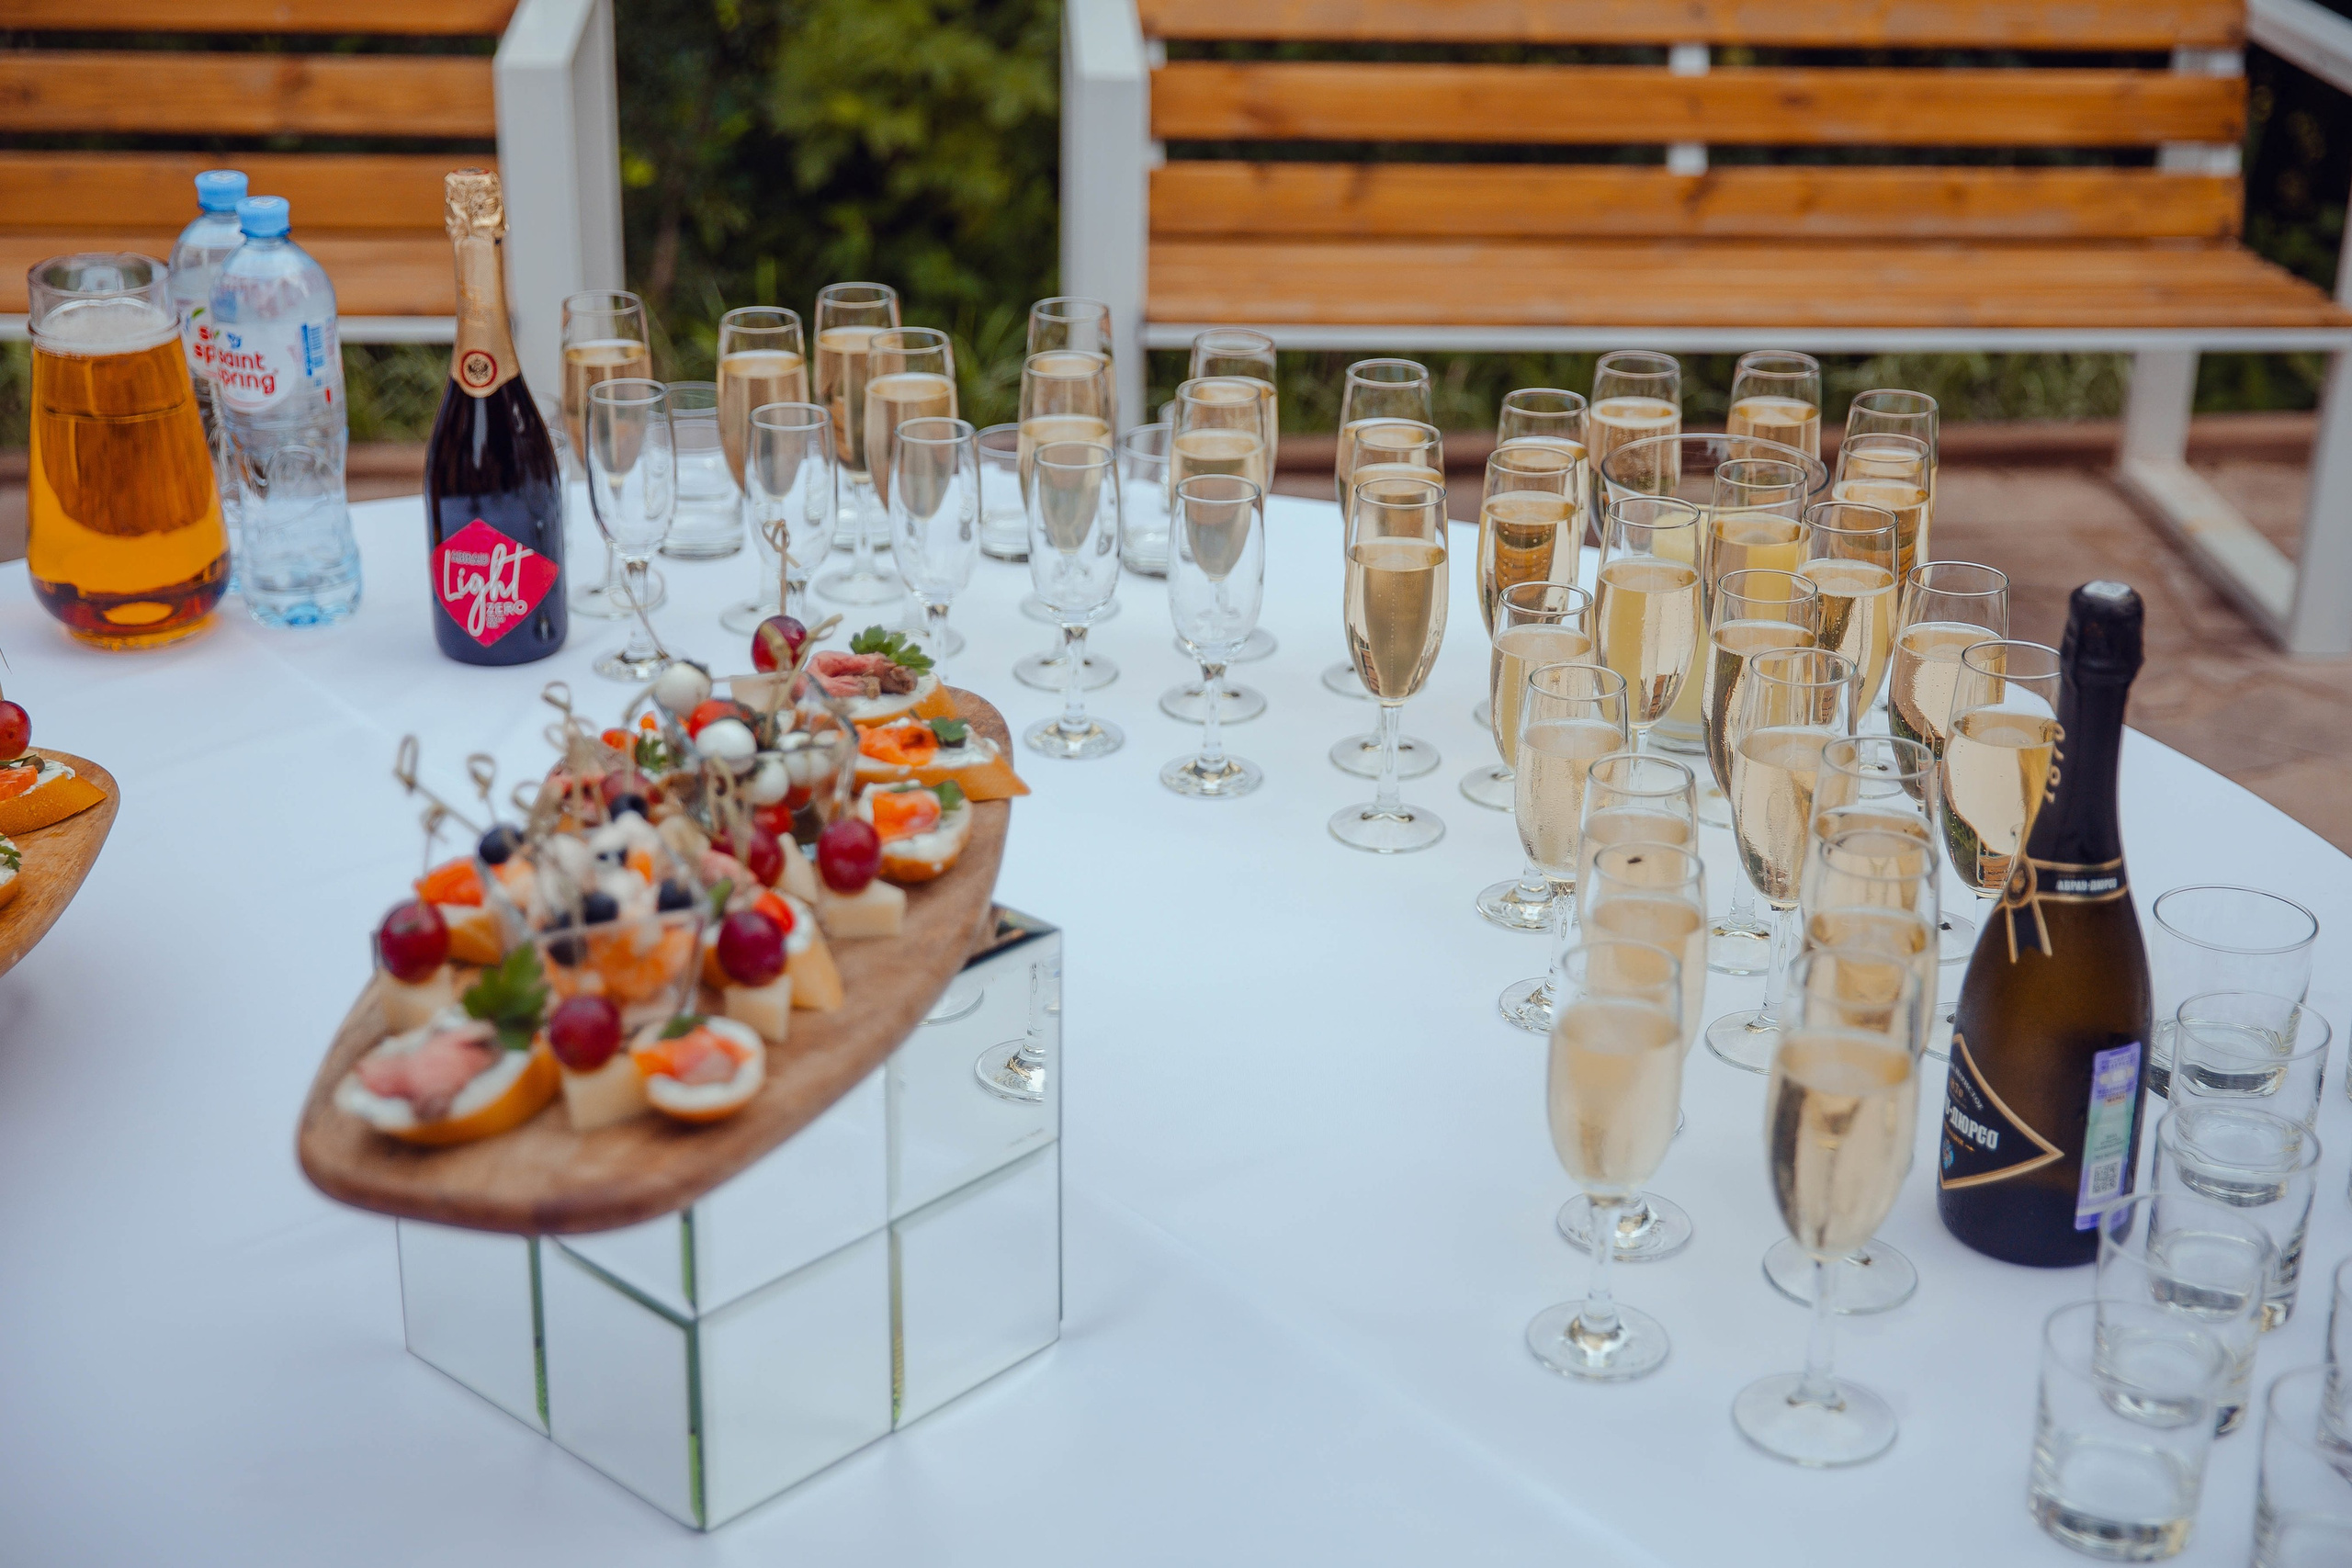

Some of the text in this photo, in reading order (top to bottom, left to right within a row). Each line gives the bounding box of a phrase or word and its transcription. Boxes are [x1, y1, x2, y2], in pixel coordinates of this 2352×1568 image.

[218, 351, 265, 370] saint
[444, 543, 535, 637] Light
[486, 600, 528, 616] ZERO
